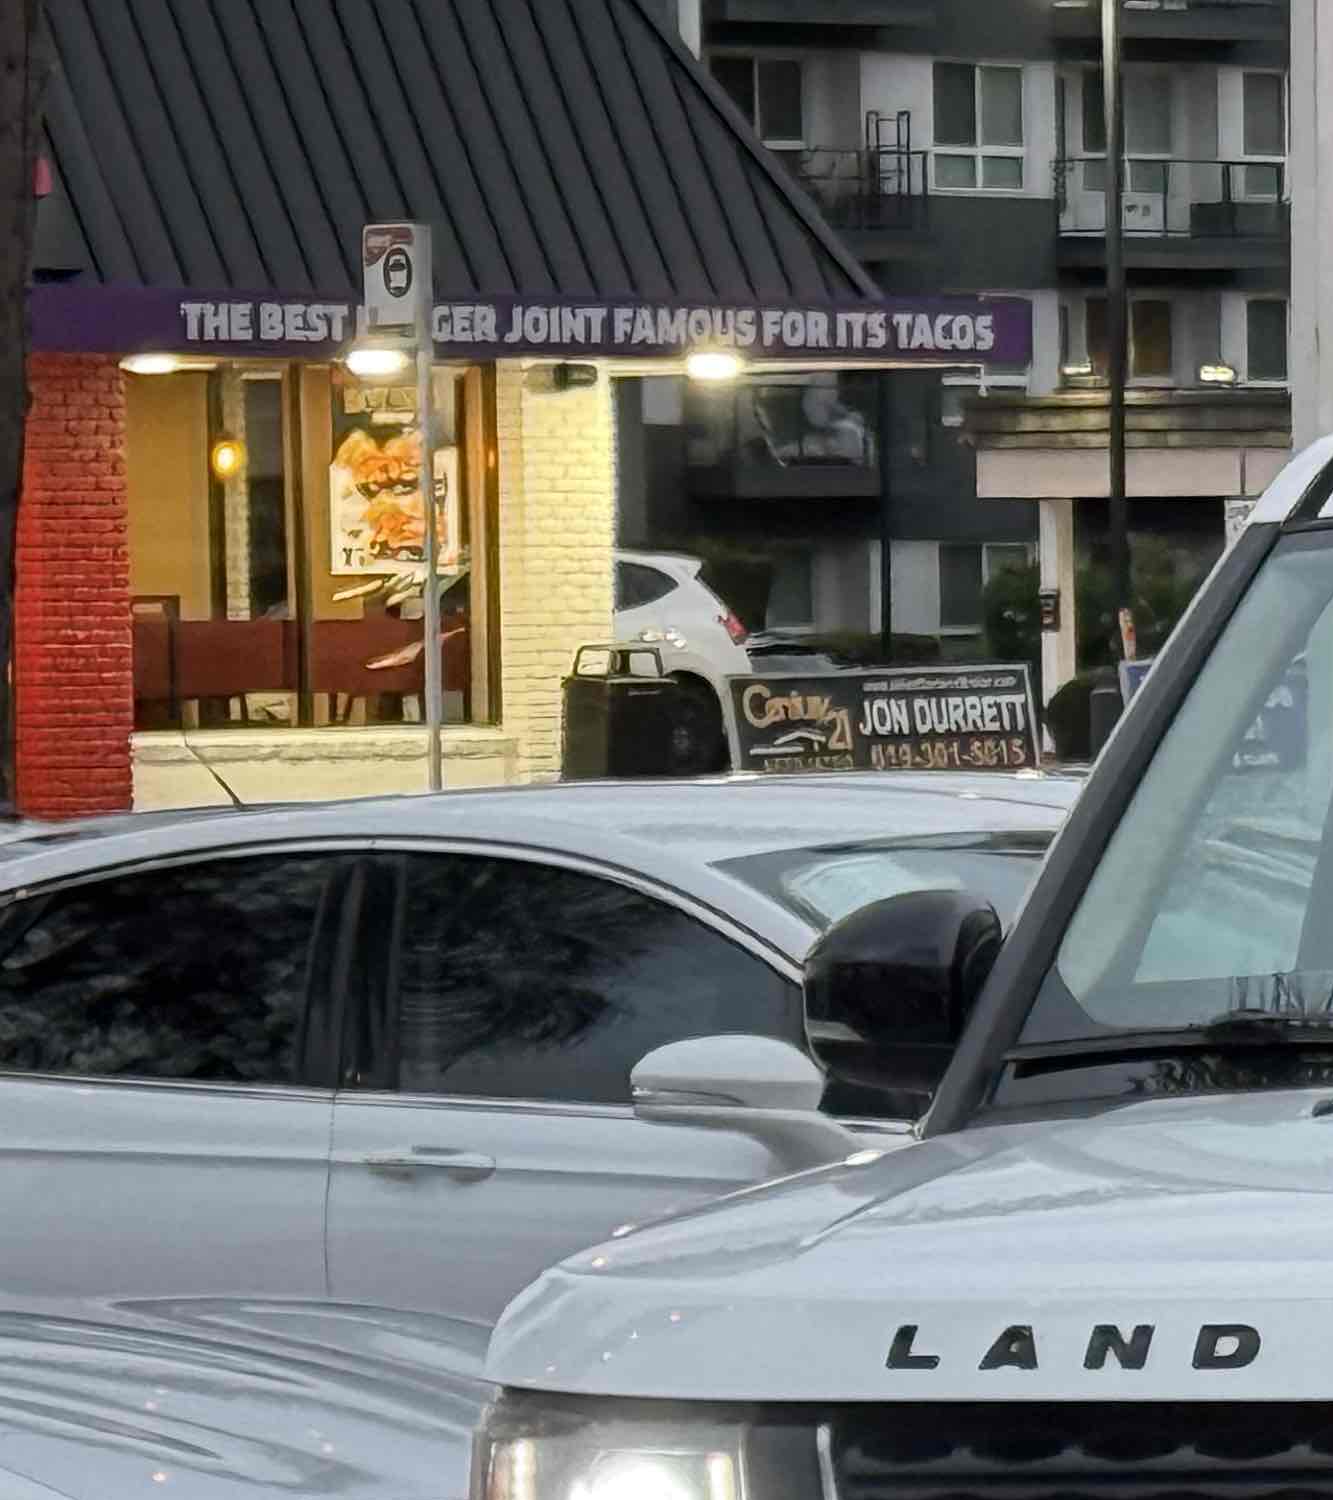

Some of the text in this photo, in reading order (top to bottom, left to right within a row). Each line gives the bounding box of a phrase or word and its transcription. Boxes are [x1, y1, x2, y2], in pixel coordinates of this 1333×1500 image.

[181, 303, 995, 350] THE BEST GER JOINT FAMOUS FOR ITS TACOS
[860, 694, 1025, 735] JON DURRETT
[886, 1324, 1262, 1370] LAND
